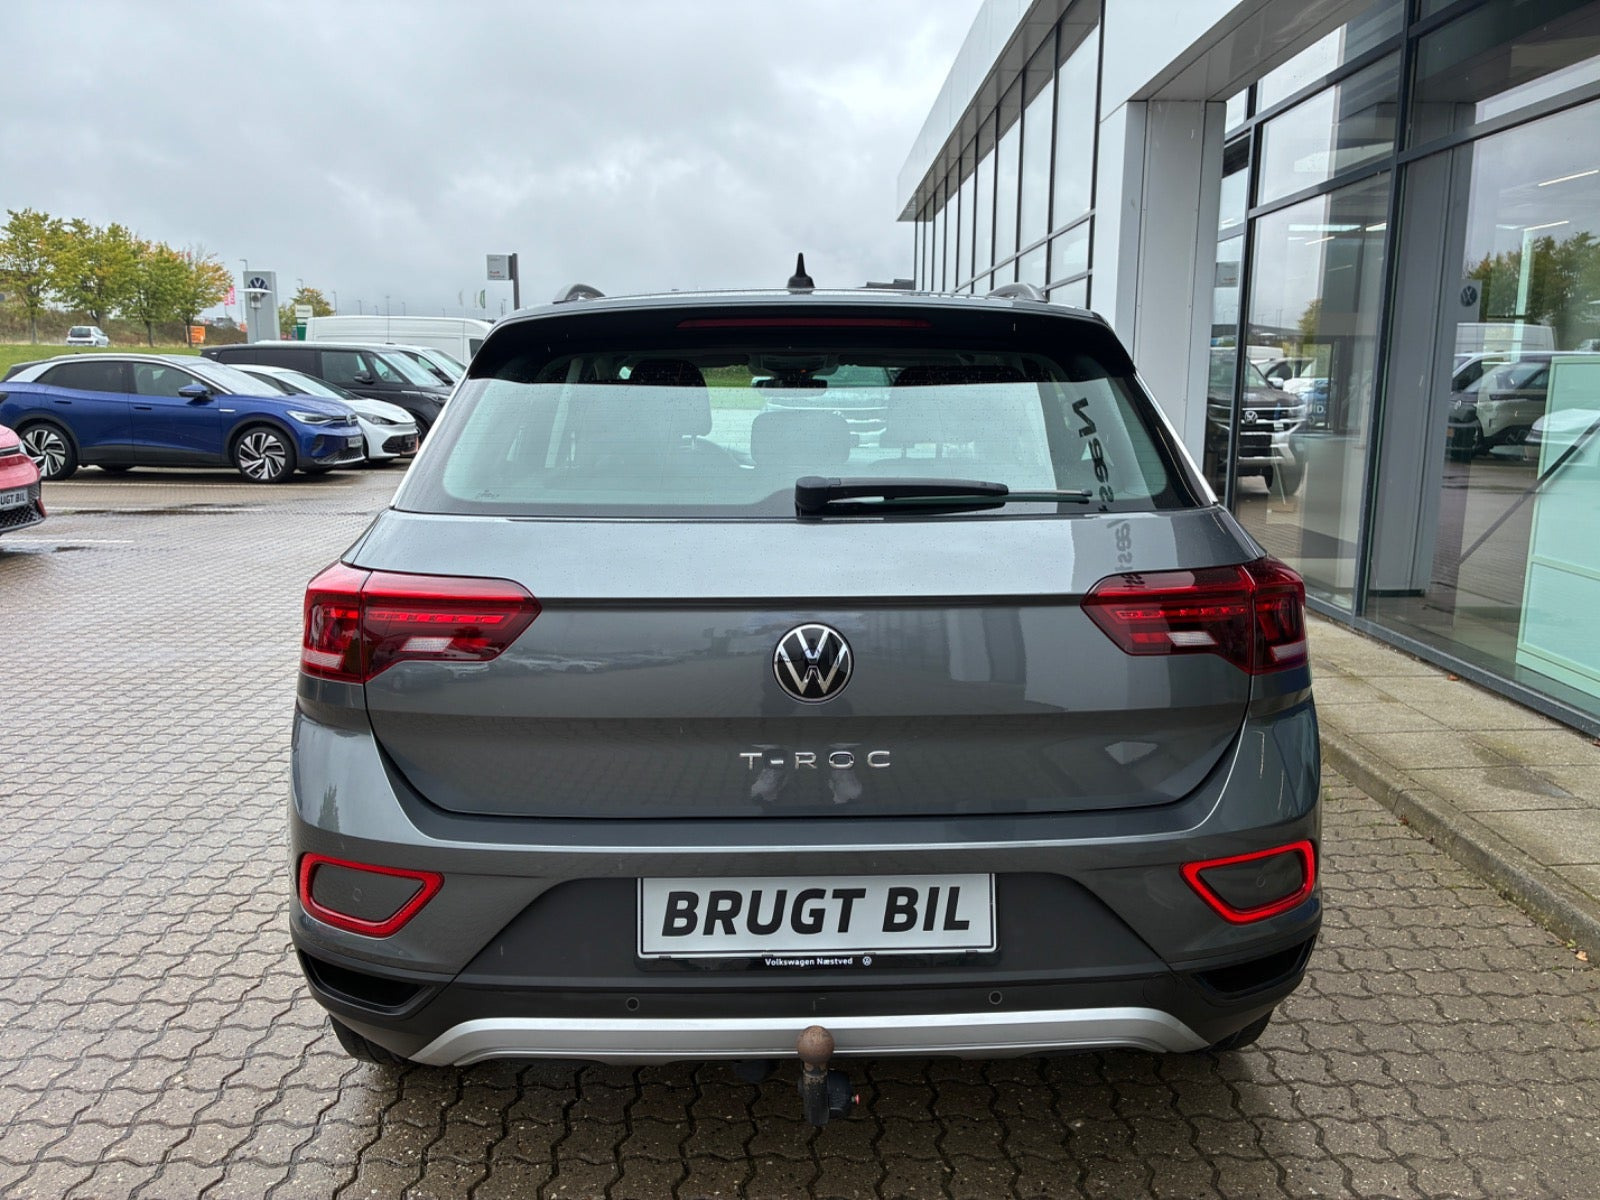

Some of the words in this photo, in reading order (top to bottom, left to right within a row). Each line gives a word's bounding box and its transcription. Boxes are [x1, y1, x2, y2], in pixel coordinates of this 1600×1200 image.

[15, 492, 26, 503] BIL
[739, 750, 892, 771] T-ROC
[661, 887, 866, 938] BRUGT
[882, 886, 971, 934] BIL
[765, 957, 815, 968] Volkswagen
[816, 957, 853, 967] Næstved
